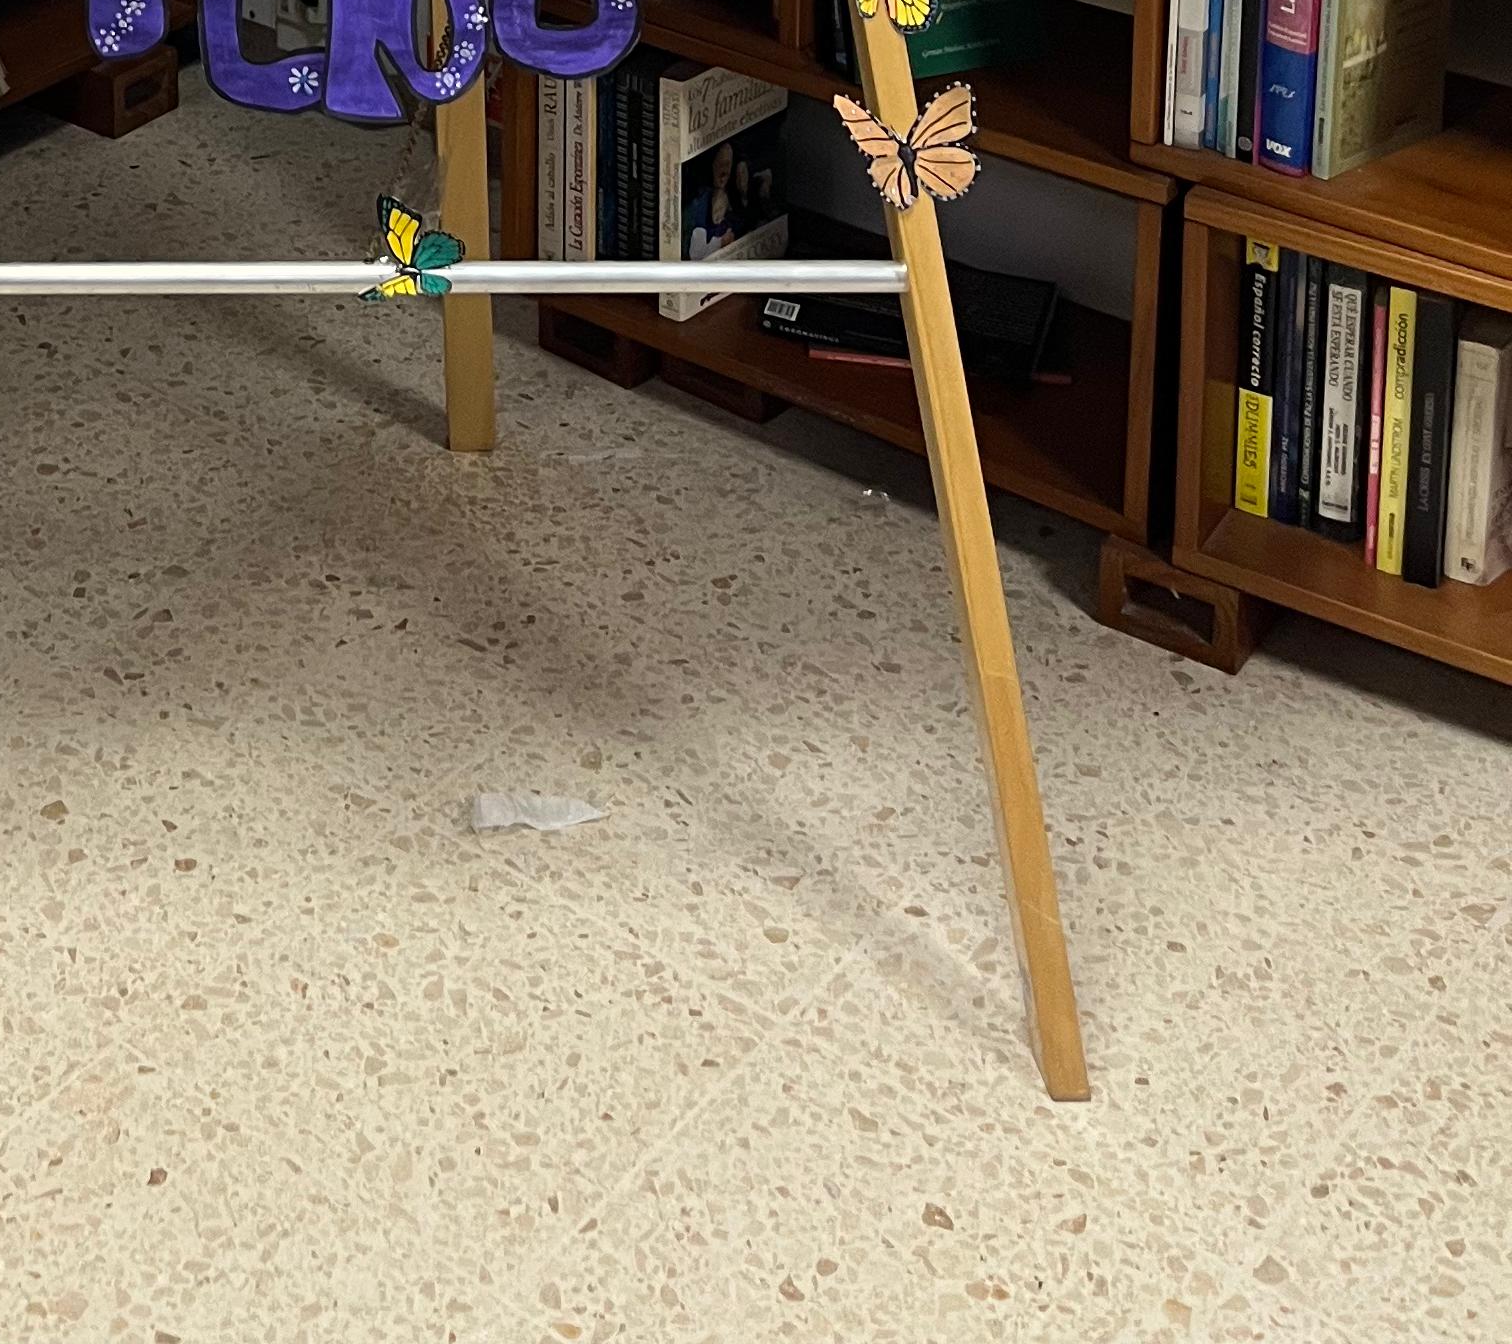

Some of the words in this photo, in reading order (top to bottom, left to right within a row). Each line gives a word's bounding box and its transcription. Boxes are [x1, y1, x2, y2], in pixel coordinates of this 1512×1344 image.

[1266, 138, 1293, 158] VOX
[1251, 273, 1266, 328] Español
[1330, 303, 1343, 326] ESTÁ
[1331, 291, 1343, 301] SE
[1344, 293, 1358, 313] QUÉ
[1248, 330, 1263, 386] correcto
[1327, 329, 1341, 386] ESPERANDO
[1342, 315, 1357, 358] ESPERAR
[1391, 312, 1409, 399] compradicción
[1339, 359, 1354, 400] CUANDO
[1243, 402, 1258, 468] DUMMIES
[1390, 417, 1403, 465] LINDSTROM
